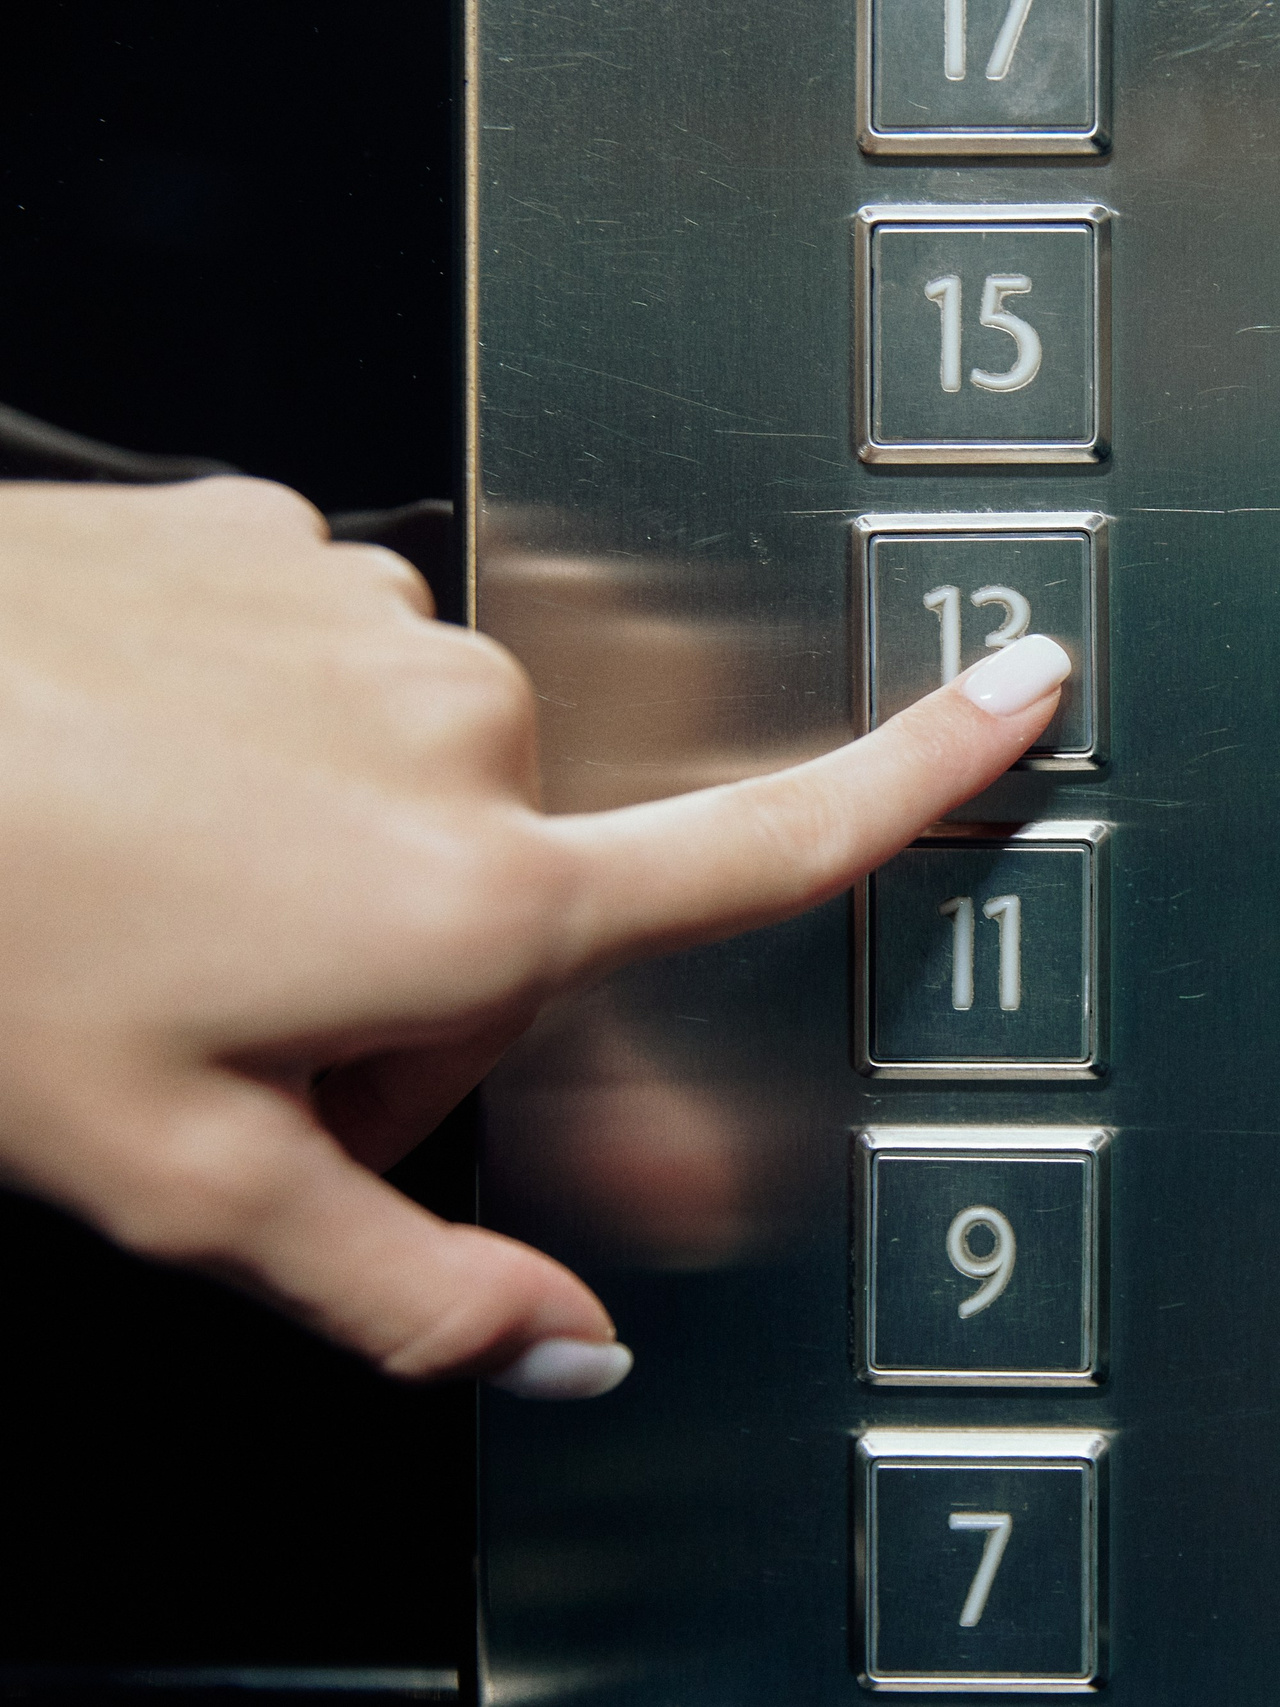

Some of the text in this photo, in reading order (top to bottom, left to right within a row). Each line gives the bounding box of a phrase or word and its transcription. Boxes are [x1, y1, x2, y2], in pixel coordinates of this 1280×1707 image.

[923, 273, 1043, 394] 15
[941, 894, 1021, 1014] 11
[945, 1205, 1016, 1320] 9
[948, 1512, 1012, 1628] 7
